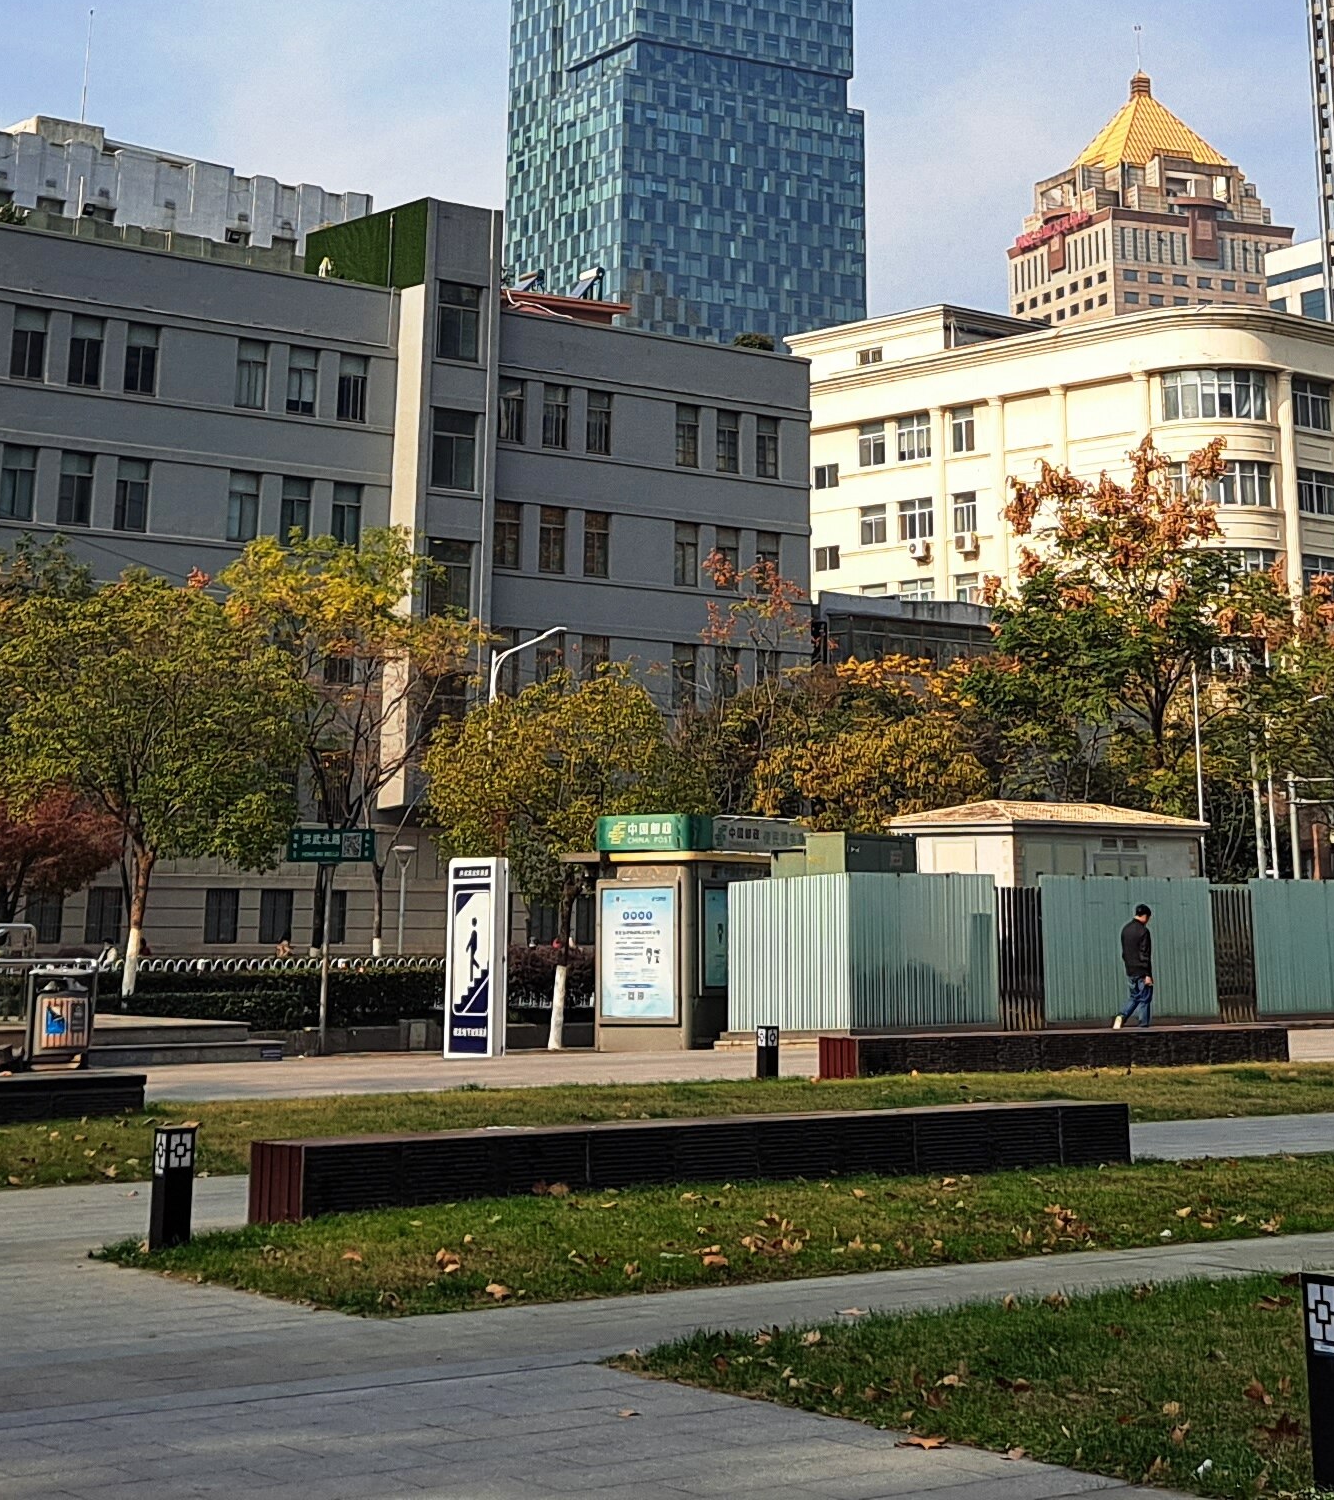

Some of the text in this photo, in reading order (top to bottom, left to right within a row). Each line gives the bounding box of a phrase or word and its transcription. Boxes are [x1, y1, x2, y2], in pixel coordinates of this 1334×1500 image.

[627, 822, 672, 836] 中国邮政
[627, 835, 672, 844] CHINA POST
